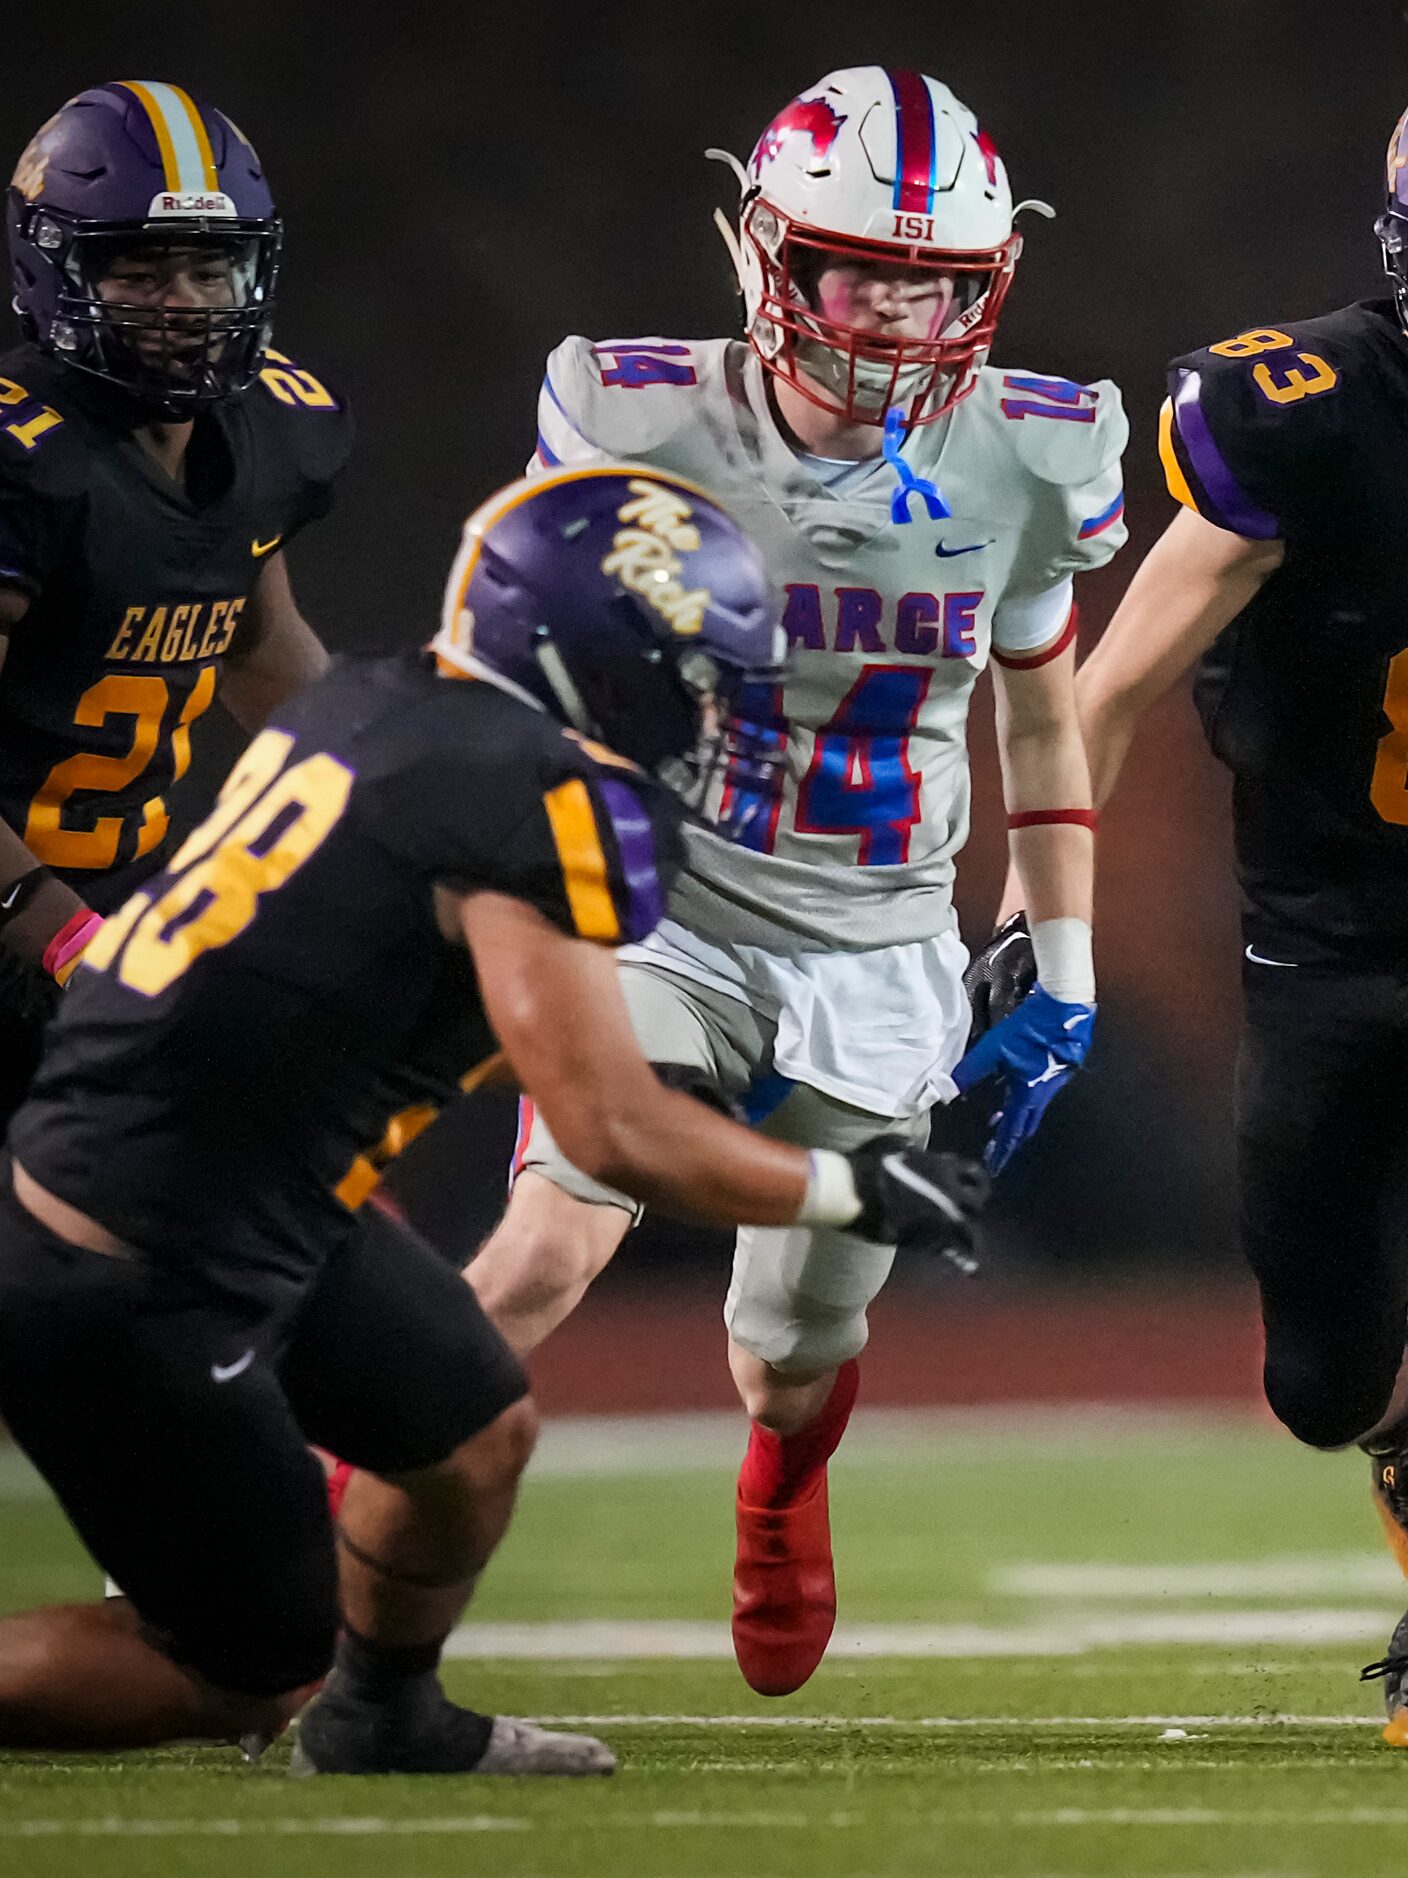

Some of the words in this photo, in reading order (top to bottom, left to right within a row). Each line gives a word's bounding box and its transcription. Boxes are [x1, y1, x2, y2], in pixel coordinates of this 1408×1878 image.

[892, 215, 934, 241] ISI
[591, 345, 697, 389] 14
[1209, 329, 1338, 405] 83
[105, 596, 247, 663] EAGLES
[781, 583, 985, 658] ARCE
